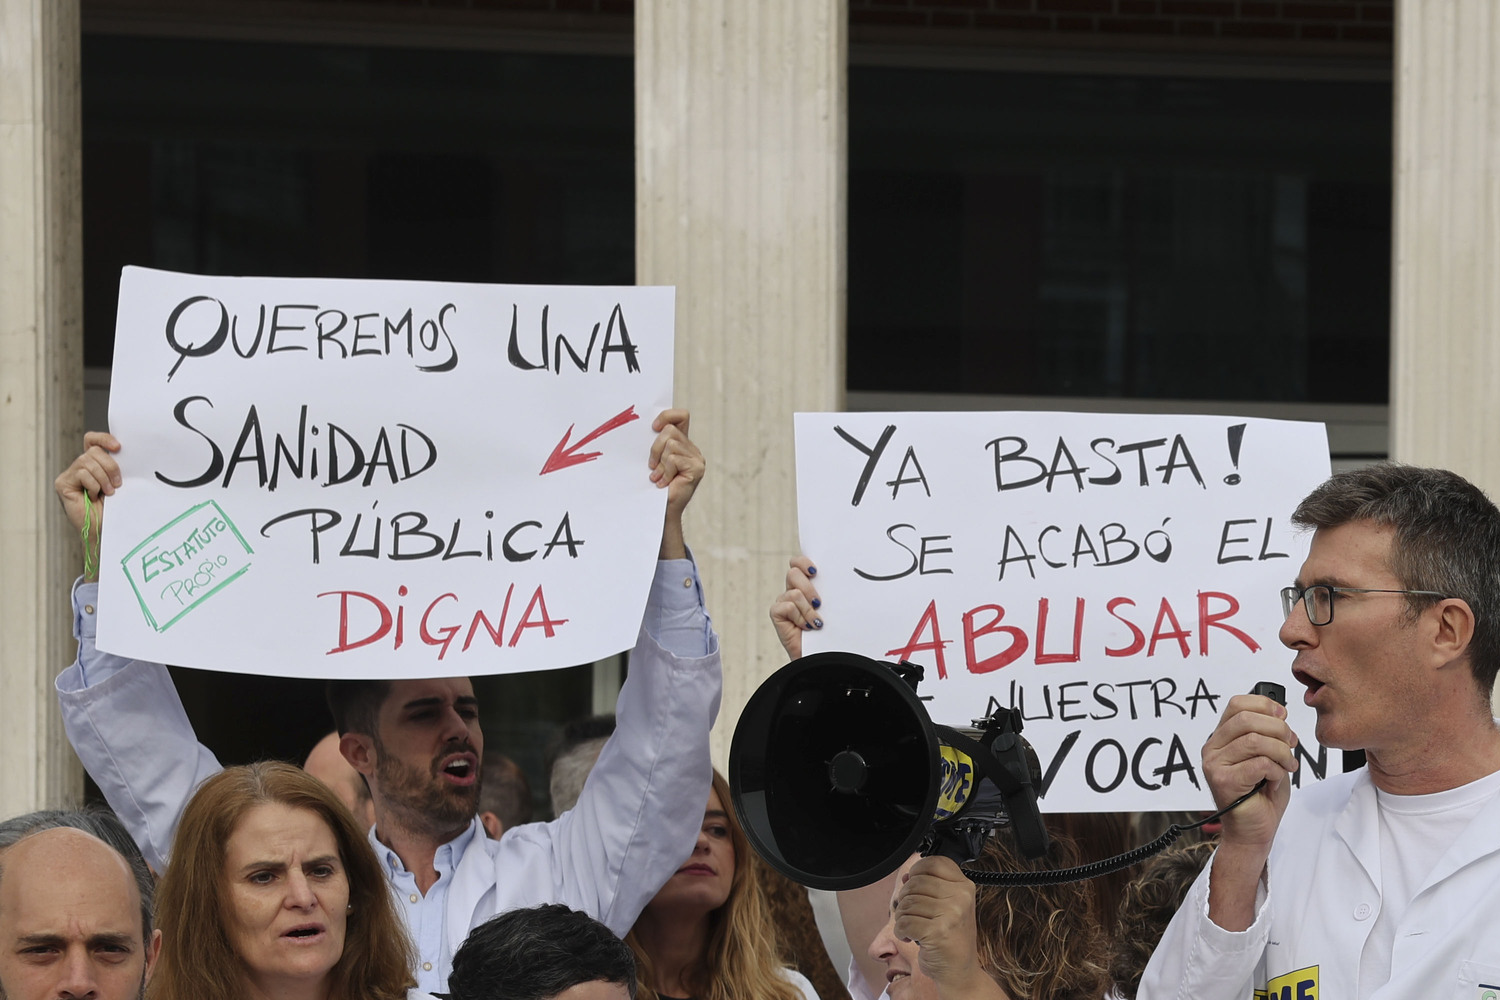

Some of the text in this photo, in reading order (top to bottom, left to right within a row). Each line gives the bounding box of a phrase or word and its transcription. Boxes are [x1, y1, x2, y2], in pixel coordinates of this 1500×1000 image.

[166, 296, 640, 382] QUEREMOS UNA
[834, 425, 930, 506] YA
[142, 517, 226, 583] ESTATUTO
[854, 517, 1289, 581] SE ACABÓ EL
[886, 590, 1261, 680] ABUSAR
